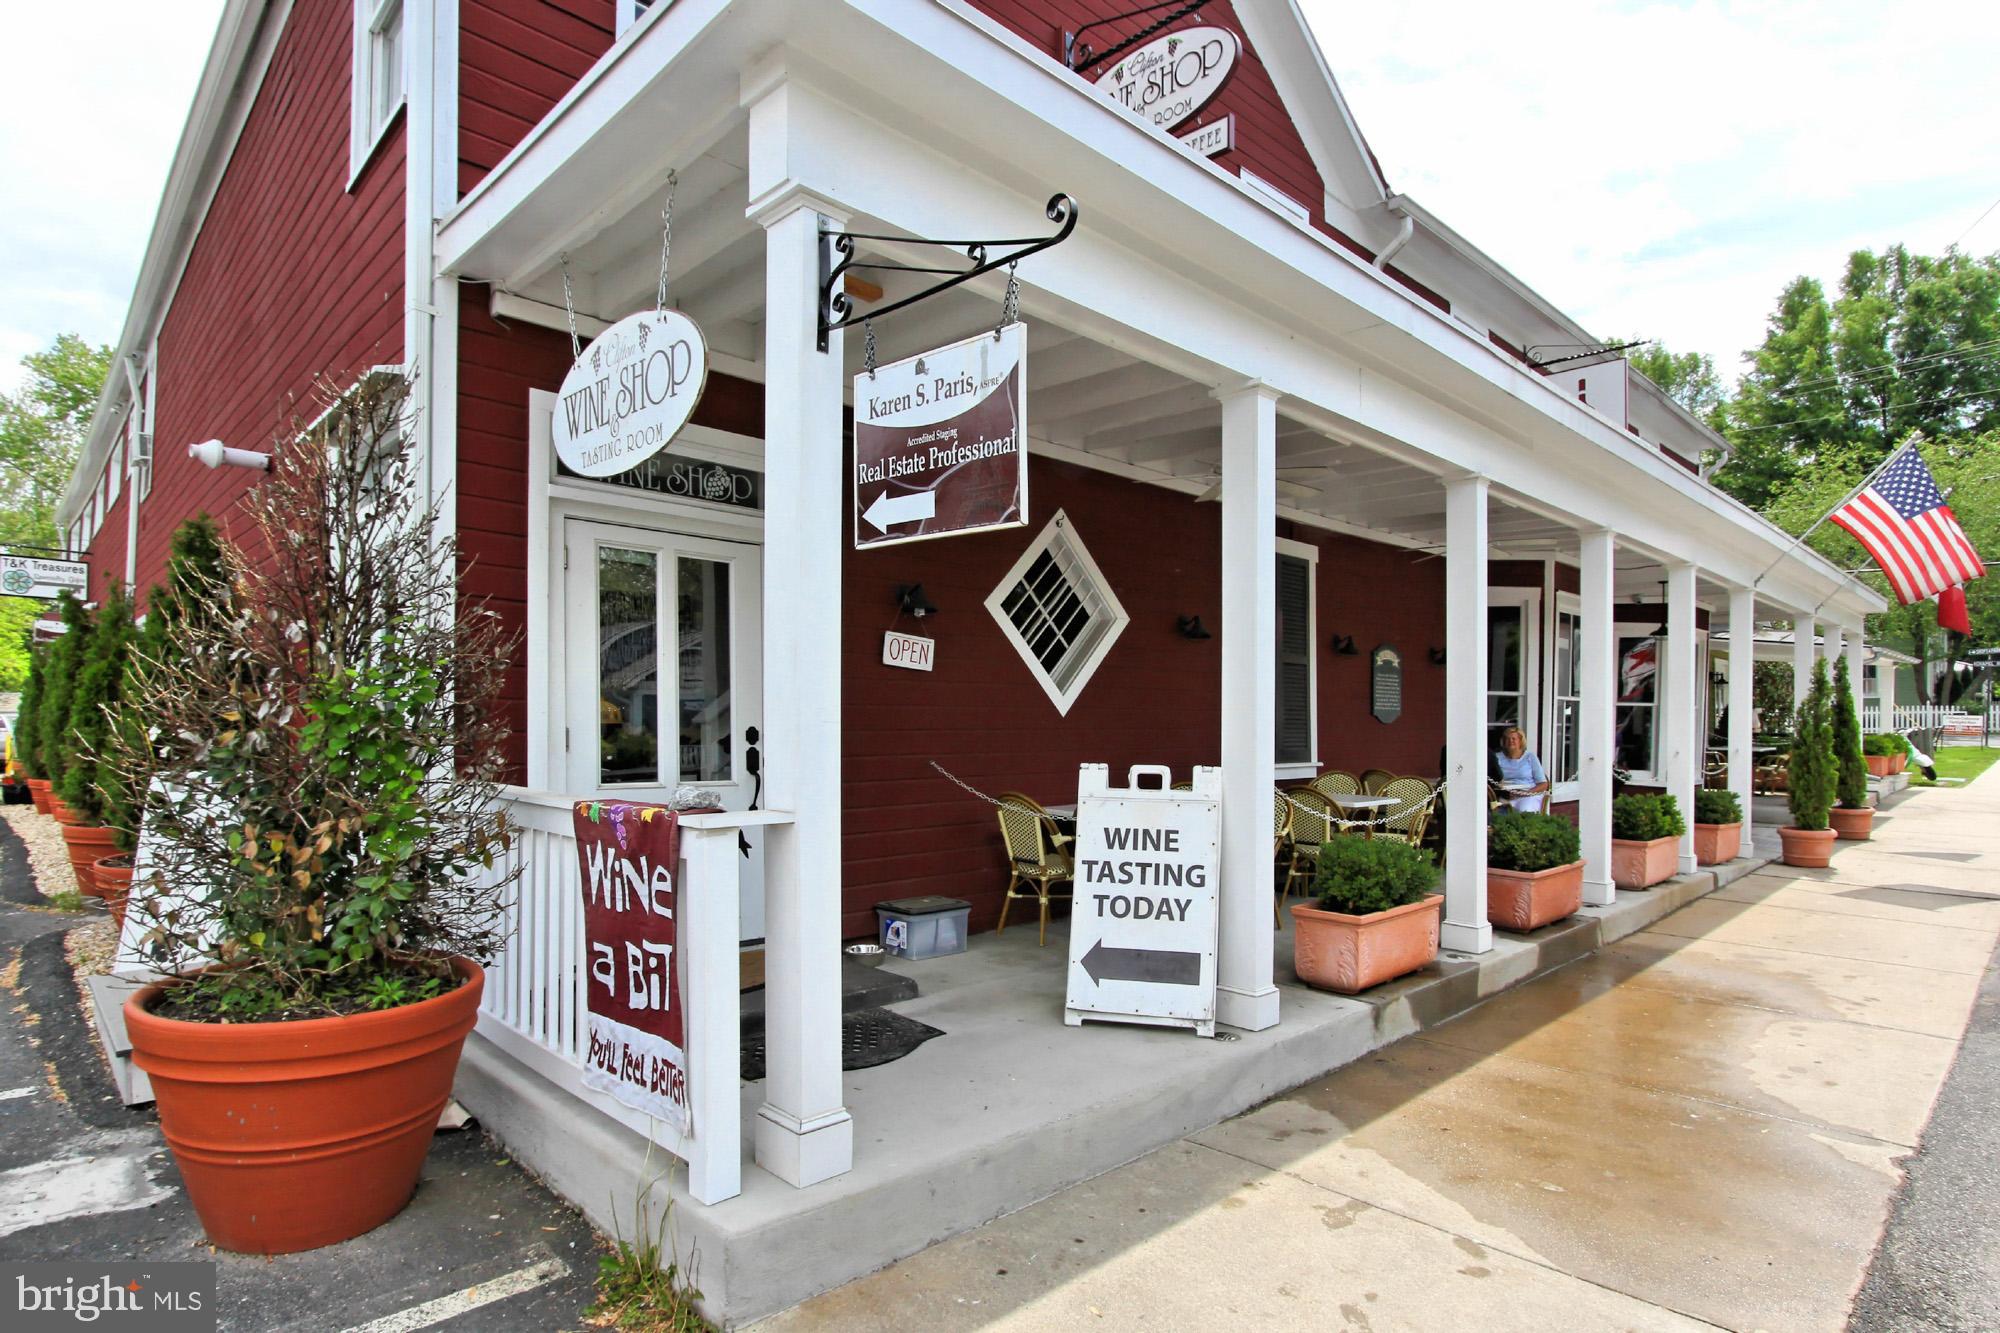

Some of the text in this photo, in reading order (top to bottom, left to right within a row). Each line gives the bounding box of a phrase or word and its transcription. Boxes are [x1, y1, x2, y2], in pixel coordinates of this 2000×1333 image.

[1142, 39, 1223, 105] SHOP
[1154, 98, 1193, 125] ROOM
[563, 339, 692, 442] WINE SHOP
[868, 393, 911, 420] Karen
[915, 383, 930, 408] S.
[934, 371, 979, 403] Paris,
[581, 422, 664, 469] TASTING ROOM
[906, 427, 958, 447] Accredited Staging
[858, 428, 1017, 485] Real Estate Professional
[2, 557, 85, 574] T&K Treasures
[889, 637, 930, 665] OPEN
[1103, 827, 1180, 853] WINE
[1081, 860, 1207, 888] TASTING
[1093, 894, 1193, 922] TODAY
